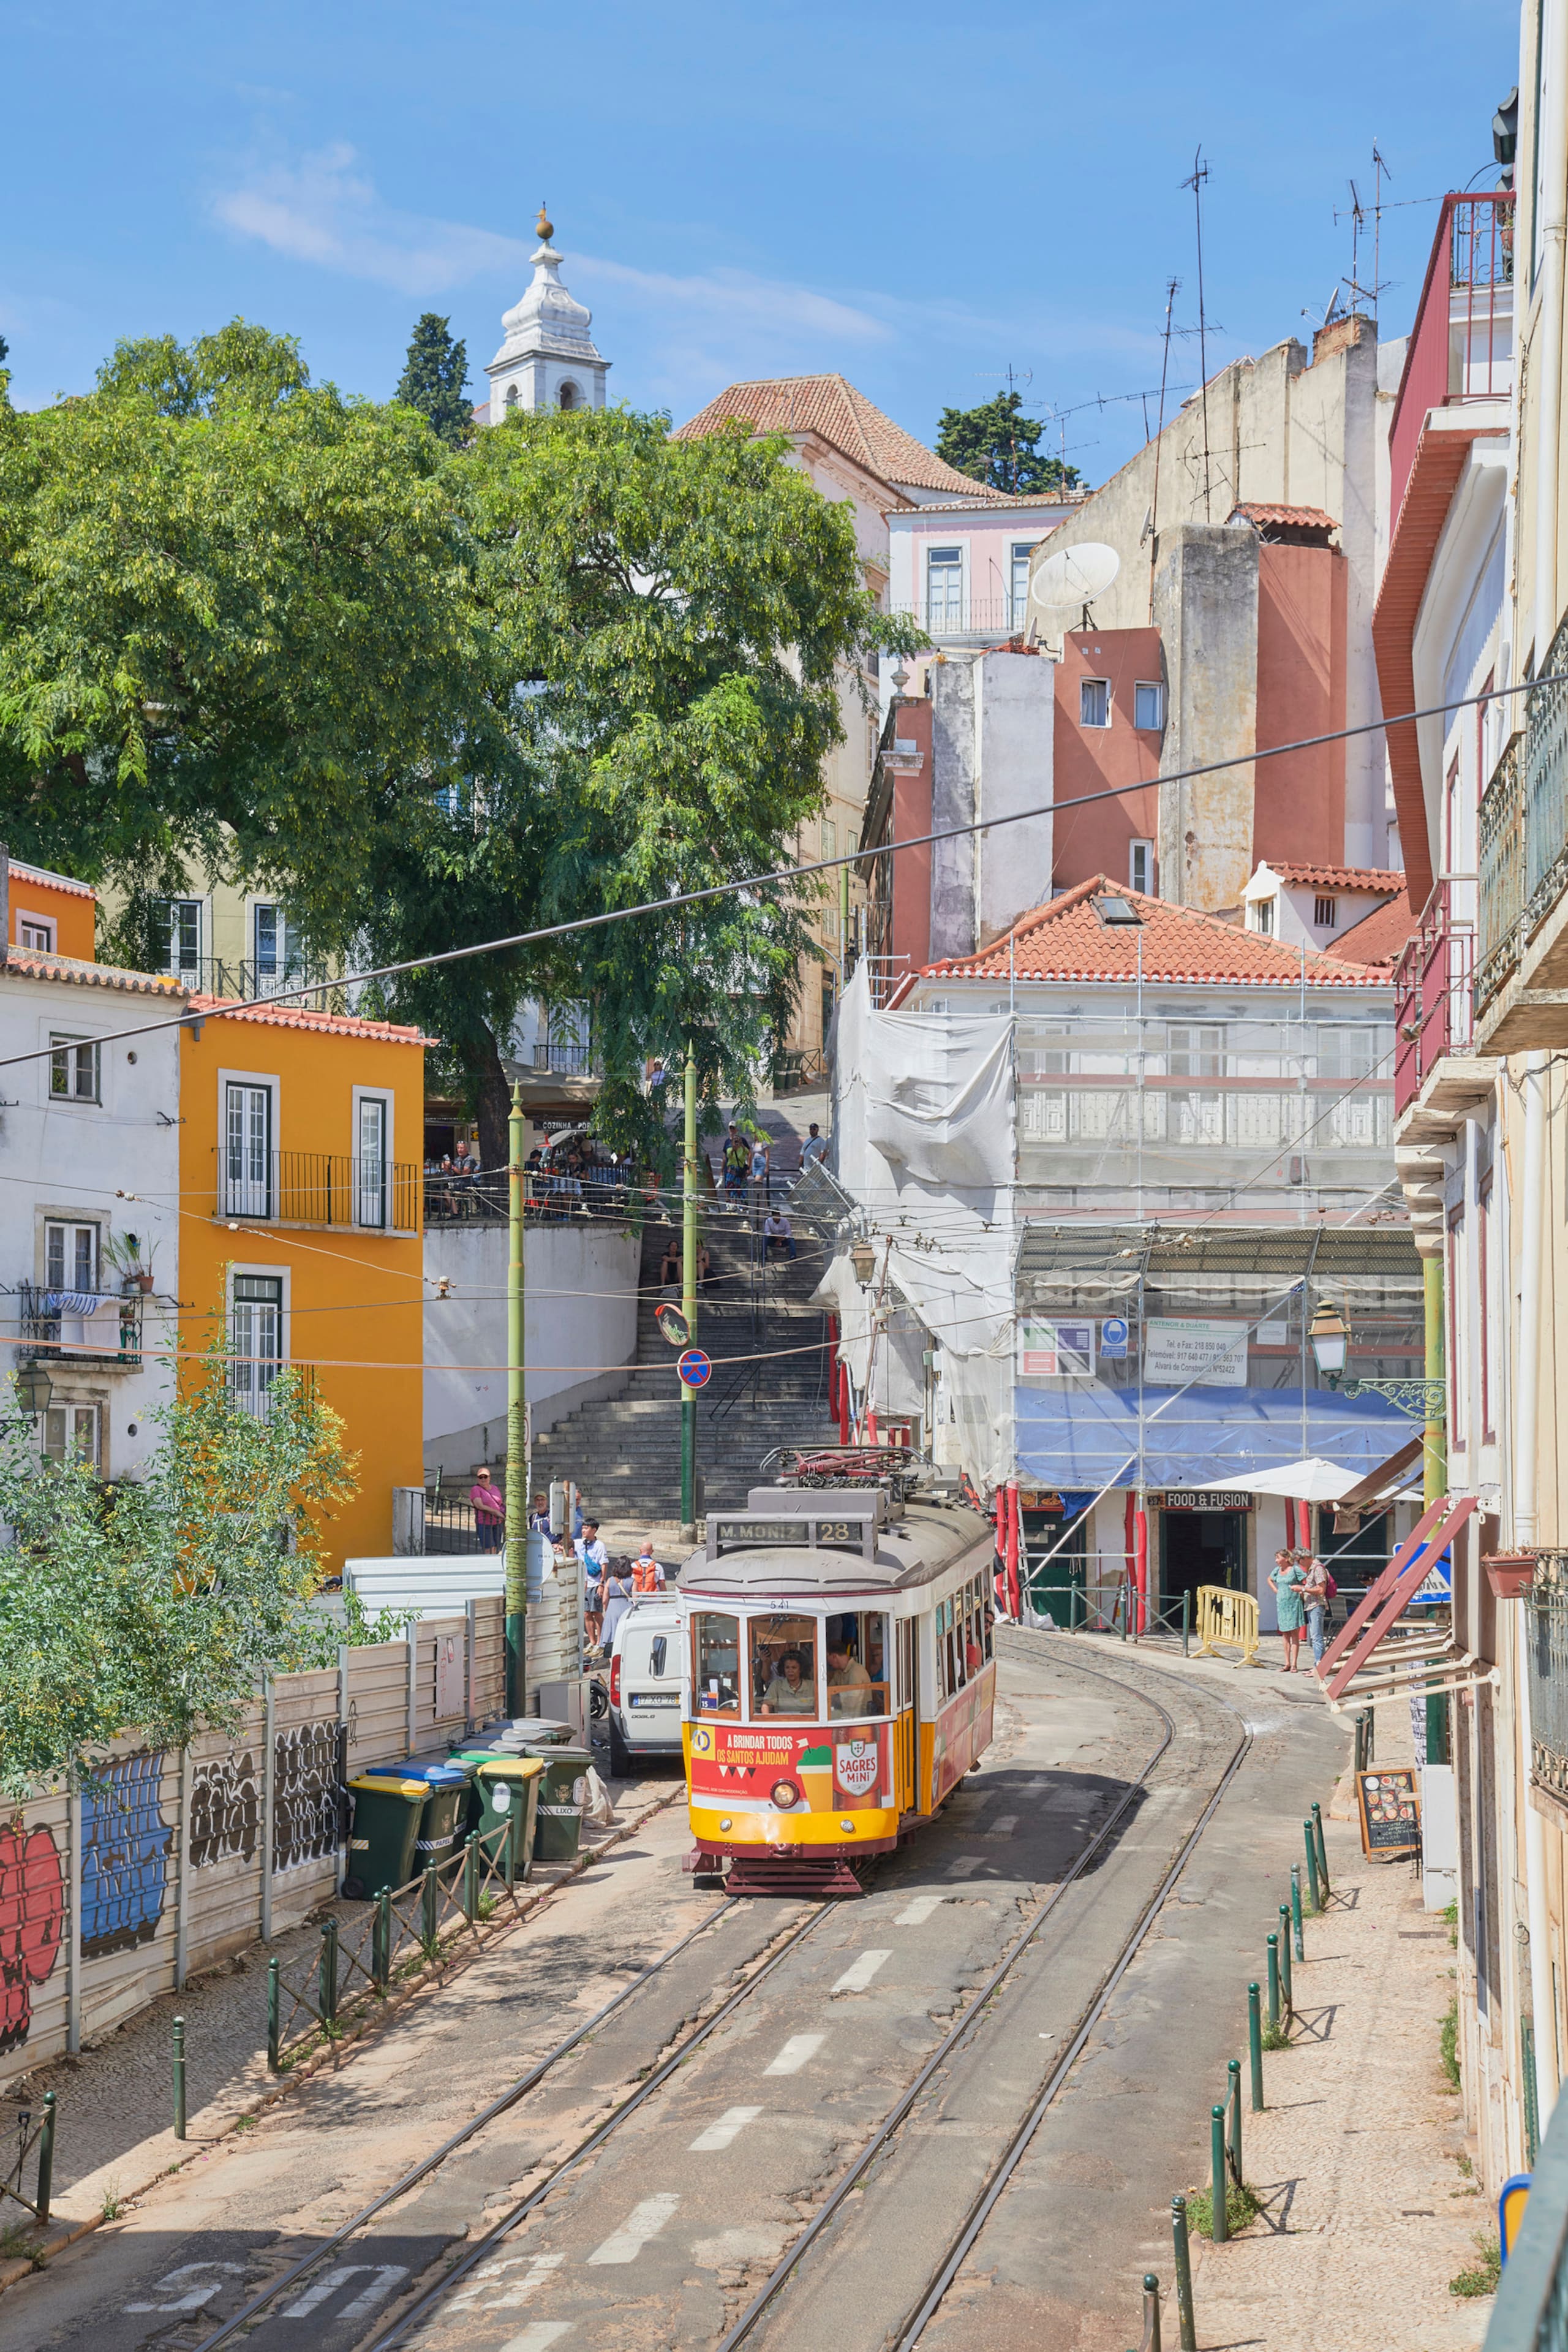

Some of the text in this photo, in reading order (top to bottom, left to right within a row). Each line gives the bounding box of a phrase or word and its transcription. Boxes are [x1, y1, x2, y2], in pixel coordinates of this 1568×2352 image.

[1155, 1361, 1172, 1370] Alvará
[1168, 1493, 1248, 1507] FOOD & FUSION
[820, 1522, 849, 1541] 28
[770, 1600, 790, 1609] 541
[727, 1734, 793, 1750] A BRINDAR TODOS
[717, 1749, 789, 1766] OS SANTOS AJUDAM
[839, 1756, 876, 1774] SAGRES
[435, 1839, 450, 1847] PAPEL
